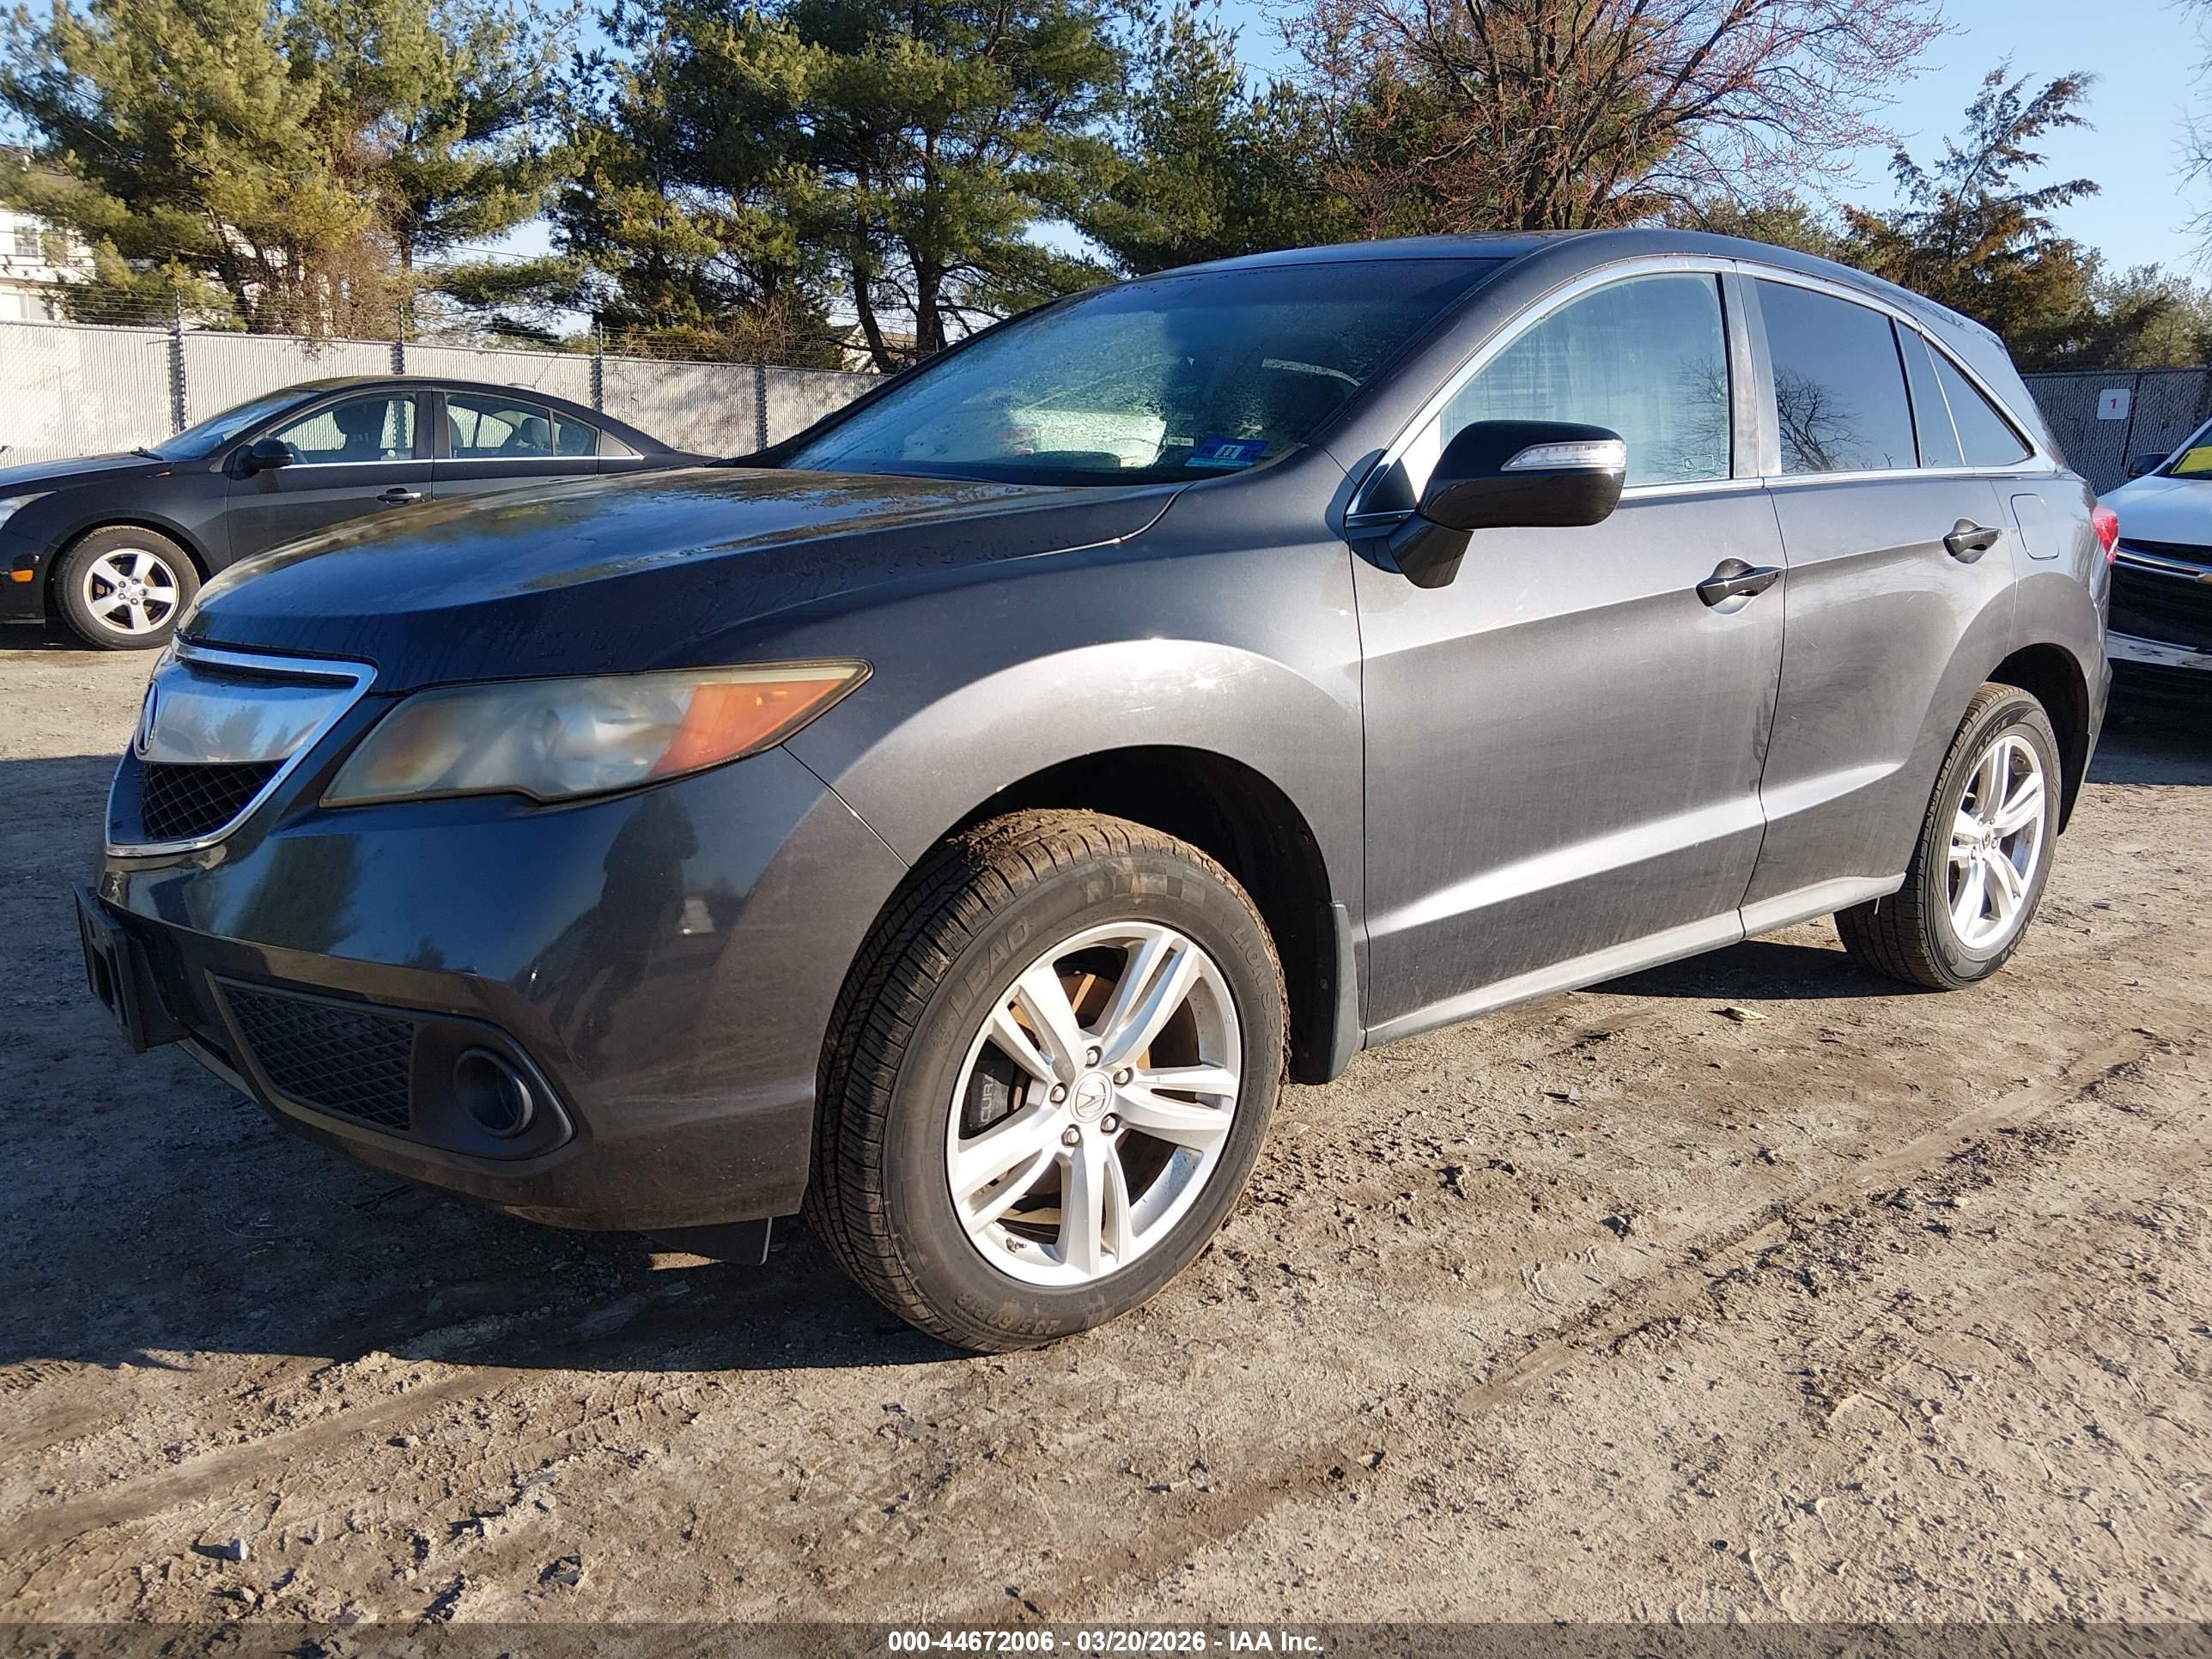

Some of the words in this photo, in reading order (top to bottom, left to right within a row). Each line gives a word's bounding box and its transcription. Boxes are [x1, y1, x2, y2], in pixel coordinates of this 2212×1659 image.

[2110, 398, 2118, 409] 1
[1230, 927, 1267, 987] LION
[1260, 991, 1279, 1098] SPORT
[979, 1067, 995, 1127] CURA
